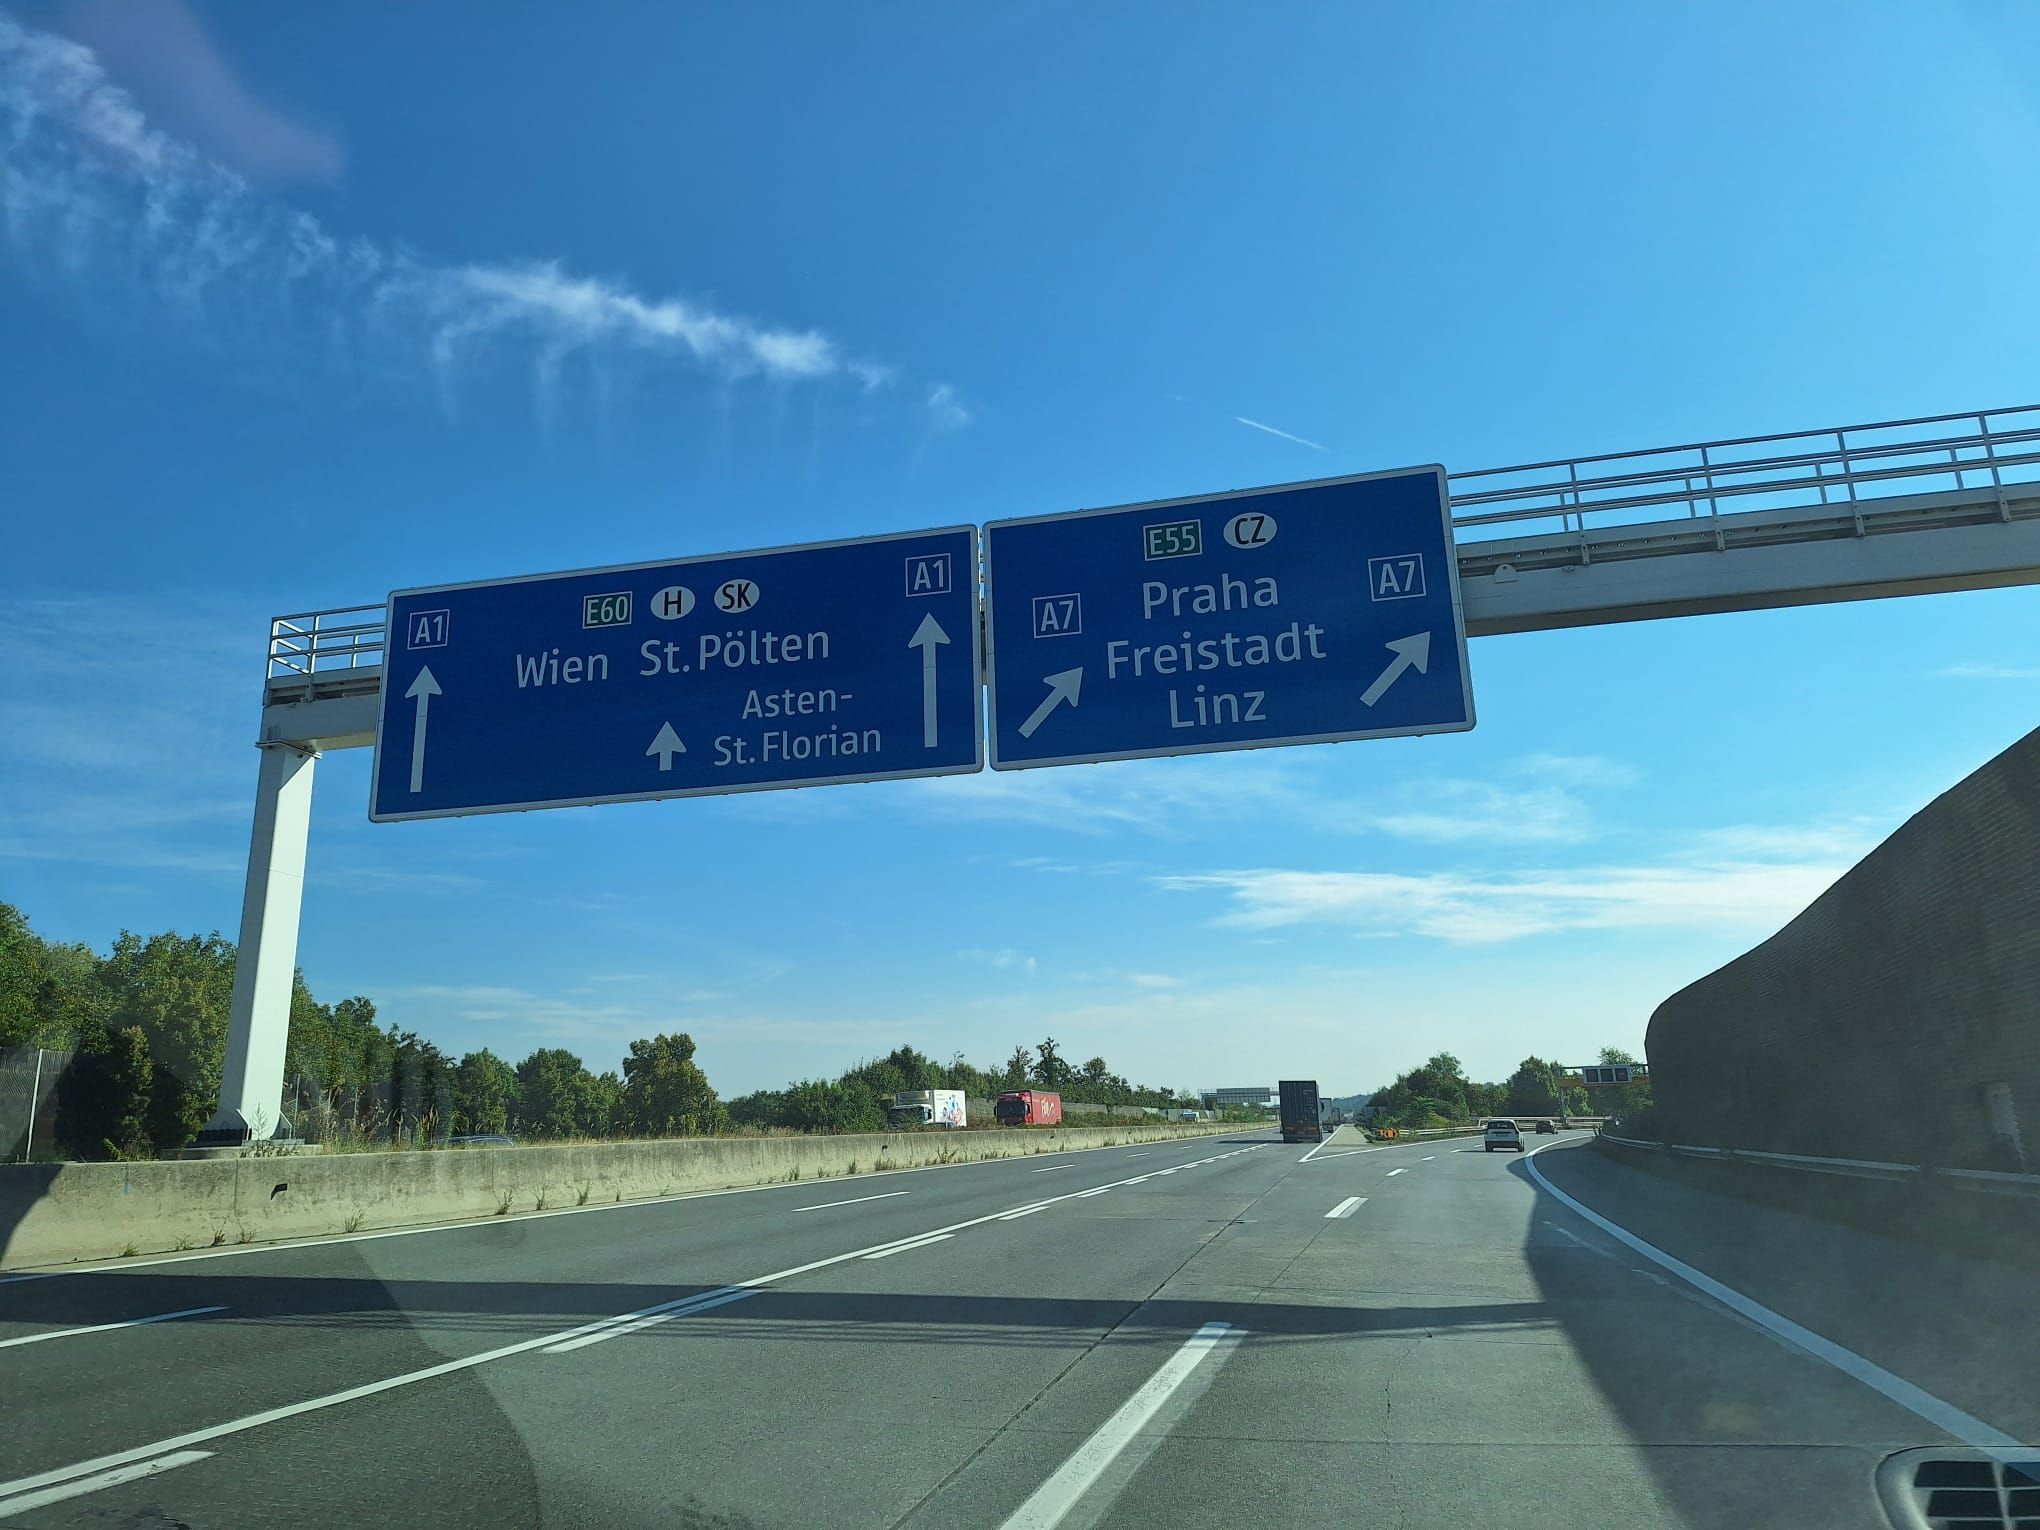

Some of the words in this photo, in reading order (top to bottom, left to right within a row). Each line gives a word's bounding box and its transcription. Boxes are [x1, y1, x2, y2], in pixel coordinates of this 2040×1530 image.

[1149, 525, 1196, 555] E55
[1233, 516, 1267, 545] CZ
[913, 560, 944, 592] A1
[1379, 561, 1417, 595] A7
[586, 597, 629, 625] E60
[664, 590, 682, 614] H
[721, 582, 752, 610] SK
[1143, 574, 1278, 619] Praha
[414, 614, 443, 643] A1
[1041, 600, 1075, 632] A7
[1108, 622, 1326, 678] Freistadt
[517, 648, 607, 688] Wien
[742, 690, 853, 719] Asten-
[1170, 685, 1266, 728] Linz
